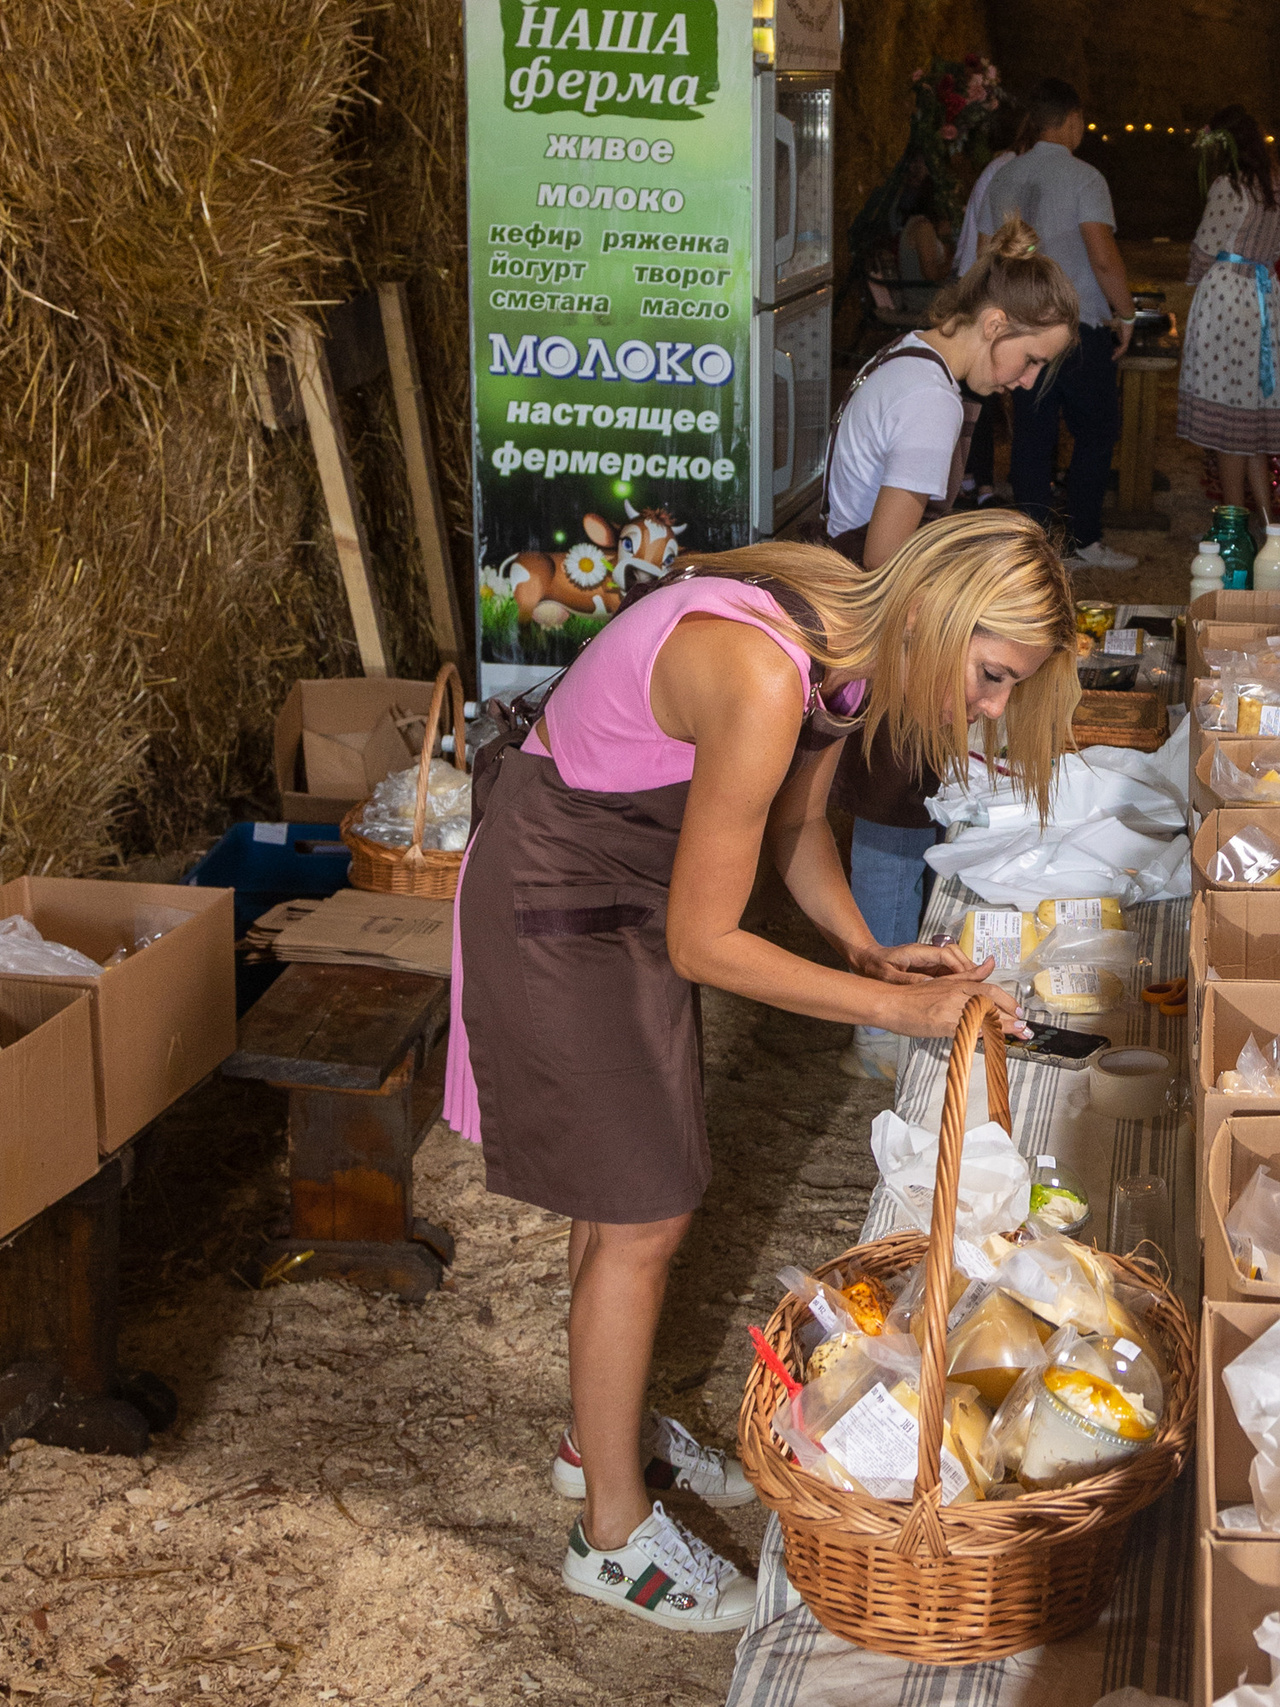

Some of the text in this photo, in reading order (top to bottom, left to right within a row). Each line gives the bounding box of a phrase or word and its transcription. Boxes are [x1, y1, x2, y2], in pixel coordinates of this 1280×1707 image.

[515, 6, 690, 55] НАША
[509, 56, 699, 112] ферма
[544, 133, 674, 163] живое
[537, 183, 685, 213] молоко
[489, 222, 730, 255] кефир ряженка
[490, 250, 731, 291] йогурт творог
[490, 289, 731, 320] сметана масло
[489, 333, 734, 386] МОЛОКО
[506, 400, 720, 437] настоящее
[491, 440, 736, 482] фермерское
